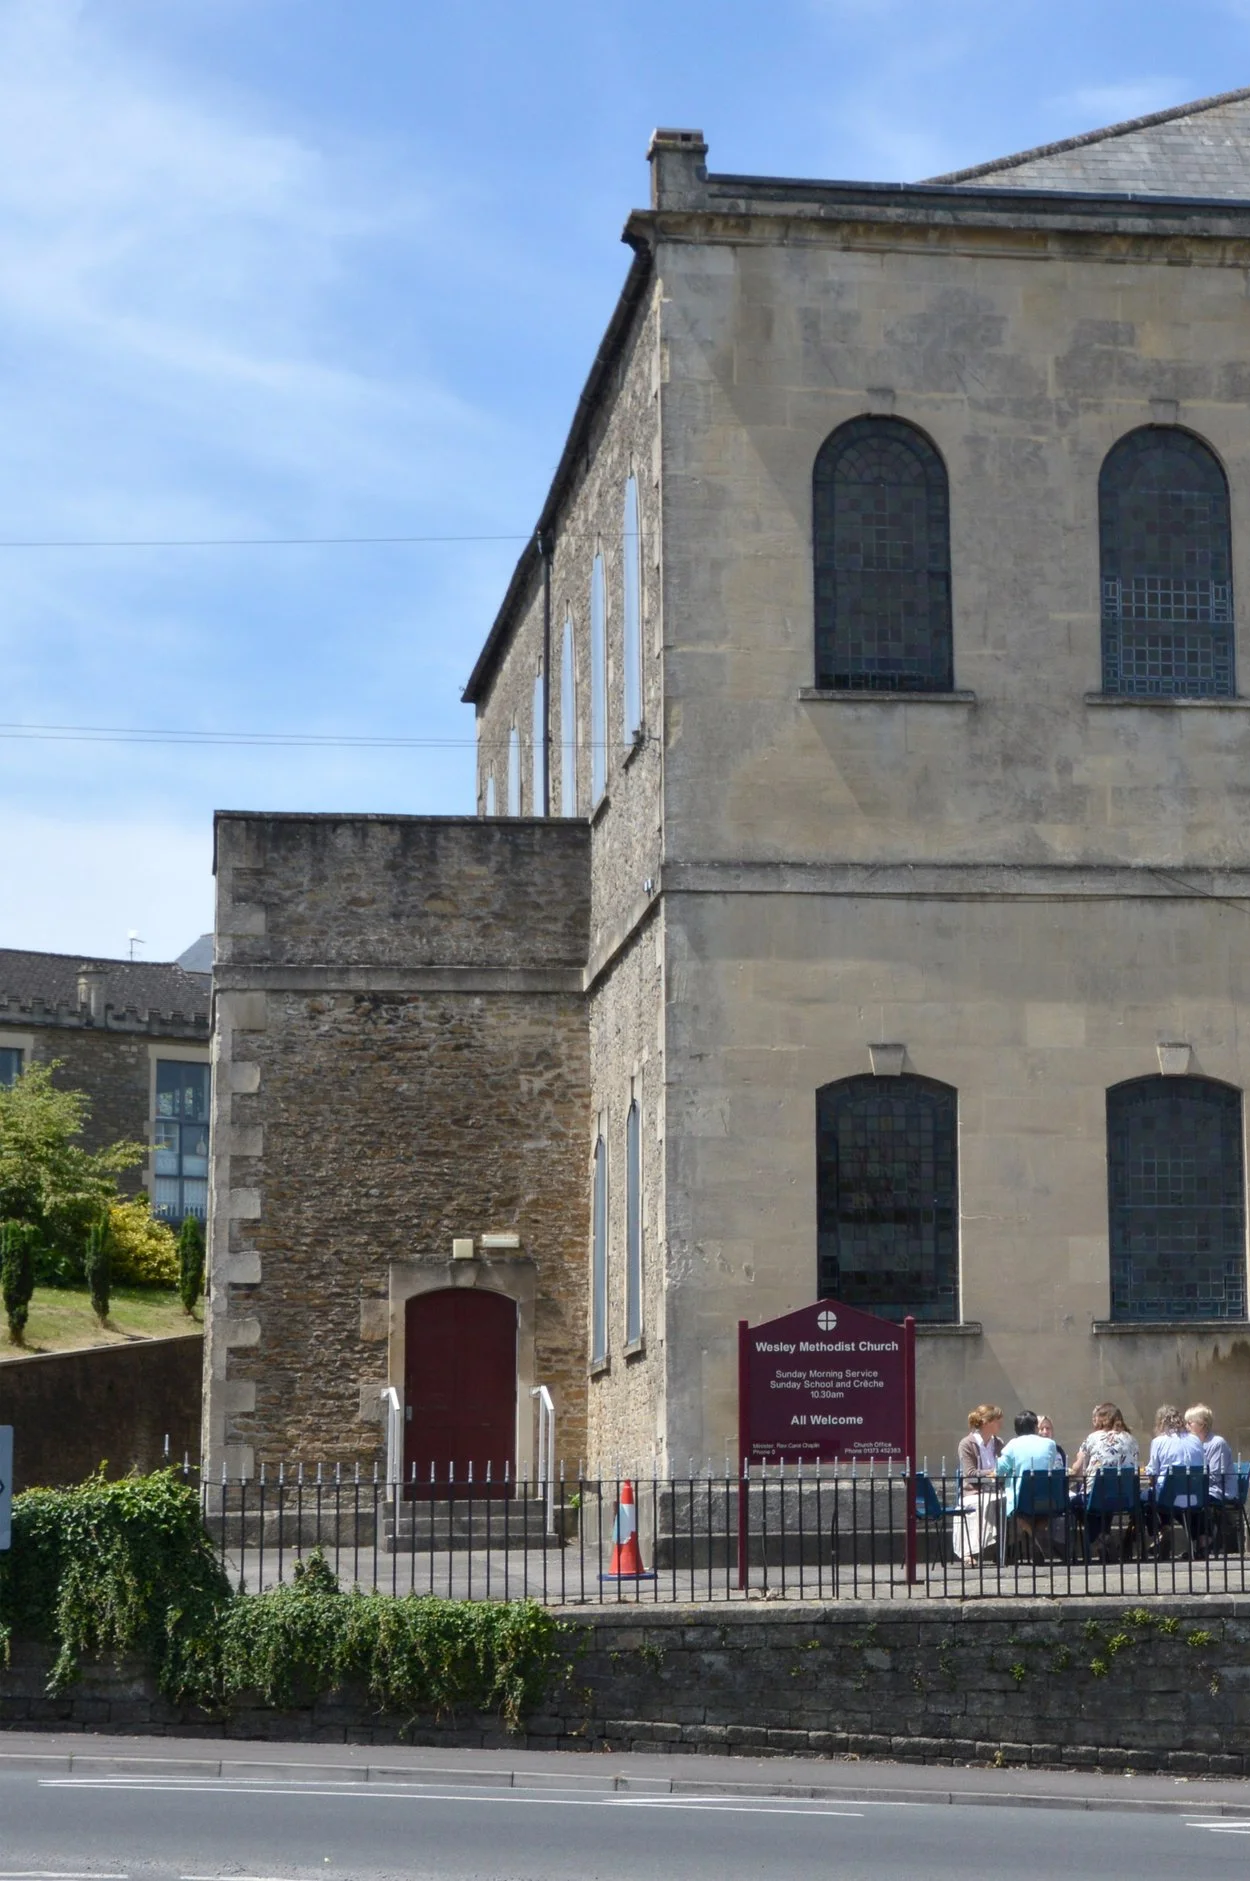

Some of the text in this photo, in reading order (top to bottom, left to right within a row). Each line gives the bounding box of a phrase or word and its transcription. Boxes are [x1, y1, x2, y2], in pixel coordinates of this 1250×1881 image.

[756, 1341, 899, 1354] Wesley Methodist Church
[776, 1369, 878, 1379] Sunday Morning Service
[770, 1380, 801, 1389] Sunday
[804, 1380, 833, 1388] School
[835, 1380, 851, 1388] and
[810, 1391, 844, 1399] 10.30am
[791, 1415, 863, 1425] All Welcome
